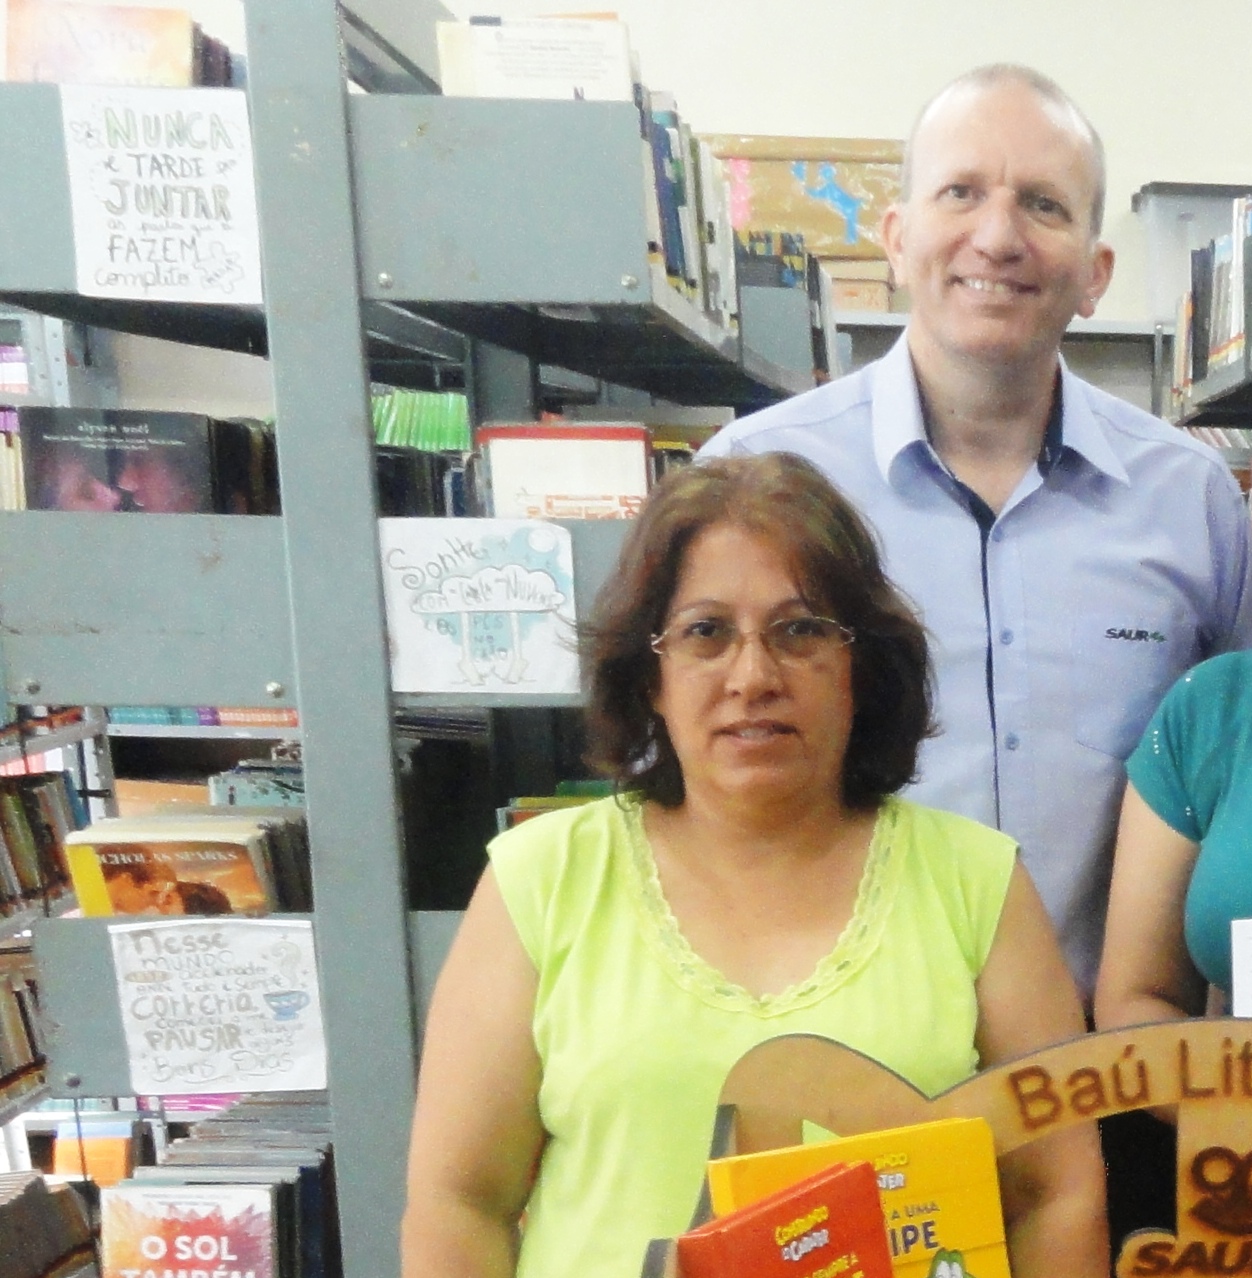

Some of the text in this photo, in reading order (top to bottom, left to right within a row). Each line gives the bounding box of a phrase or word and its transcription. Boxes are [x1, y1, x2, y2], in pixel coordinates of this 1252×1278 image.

[104, 107, 234, 151] NUNCA
[127, 152, 205, 179] TARDE
[104, 179, 231, 221] JUNTAR
[107, 234, 200, 263] FAZEM
[1104, 628, 1149, 642] SAUR
[144, 1023, 244, 1052] PAUSAR
[1008, 1043, 1151, 1131] Baú
[140, 1235, 238, 1261] O SOL
[890, 1220, 939, 1258] IPE
